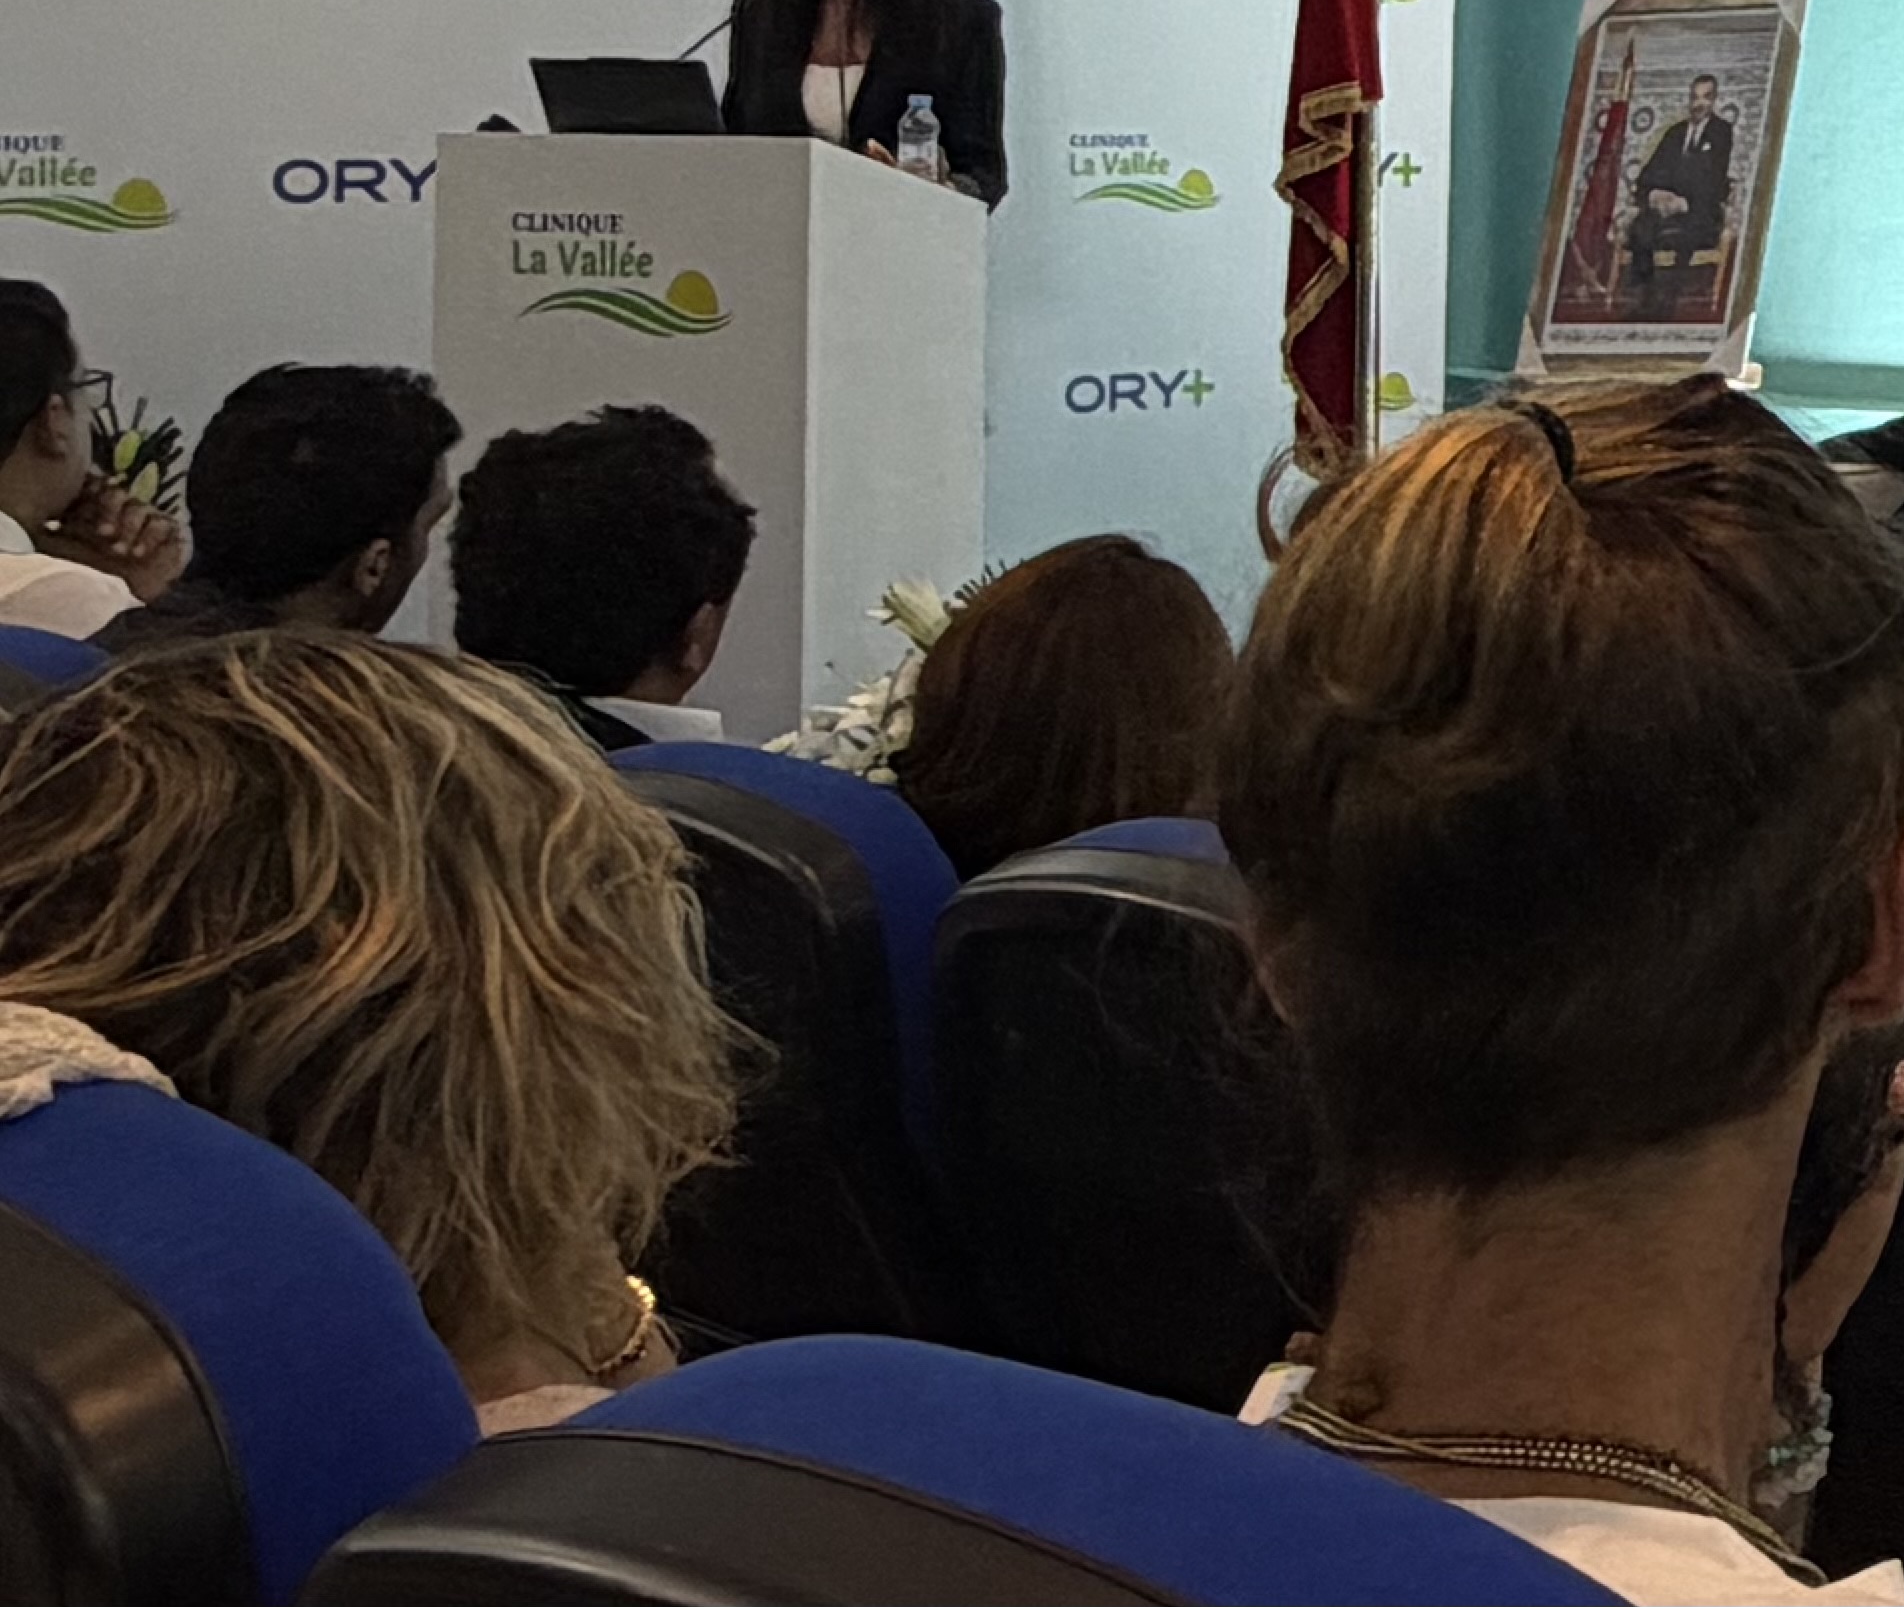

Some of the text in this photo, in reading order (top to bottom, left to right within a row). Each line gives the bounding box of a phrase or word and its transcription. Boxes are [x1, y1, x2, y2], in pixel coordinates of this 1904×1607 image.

[272, 157, 437, 204] ORY
[1069, 150, 1170, 177] La Vallée
[512, 211, 624, 237] CLINIQUE
[512, 239, 654, 278] La Vallée
[1065, 367, 1216, 415] ORY+
